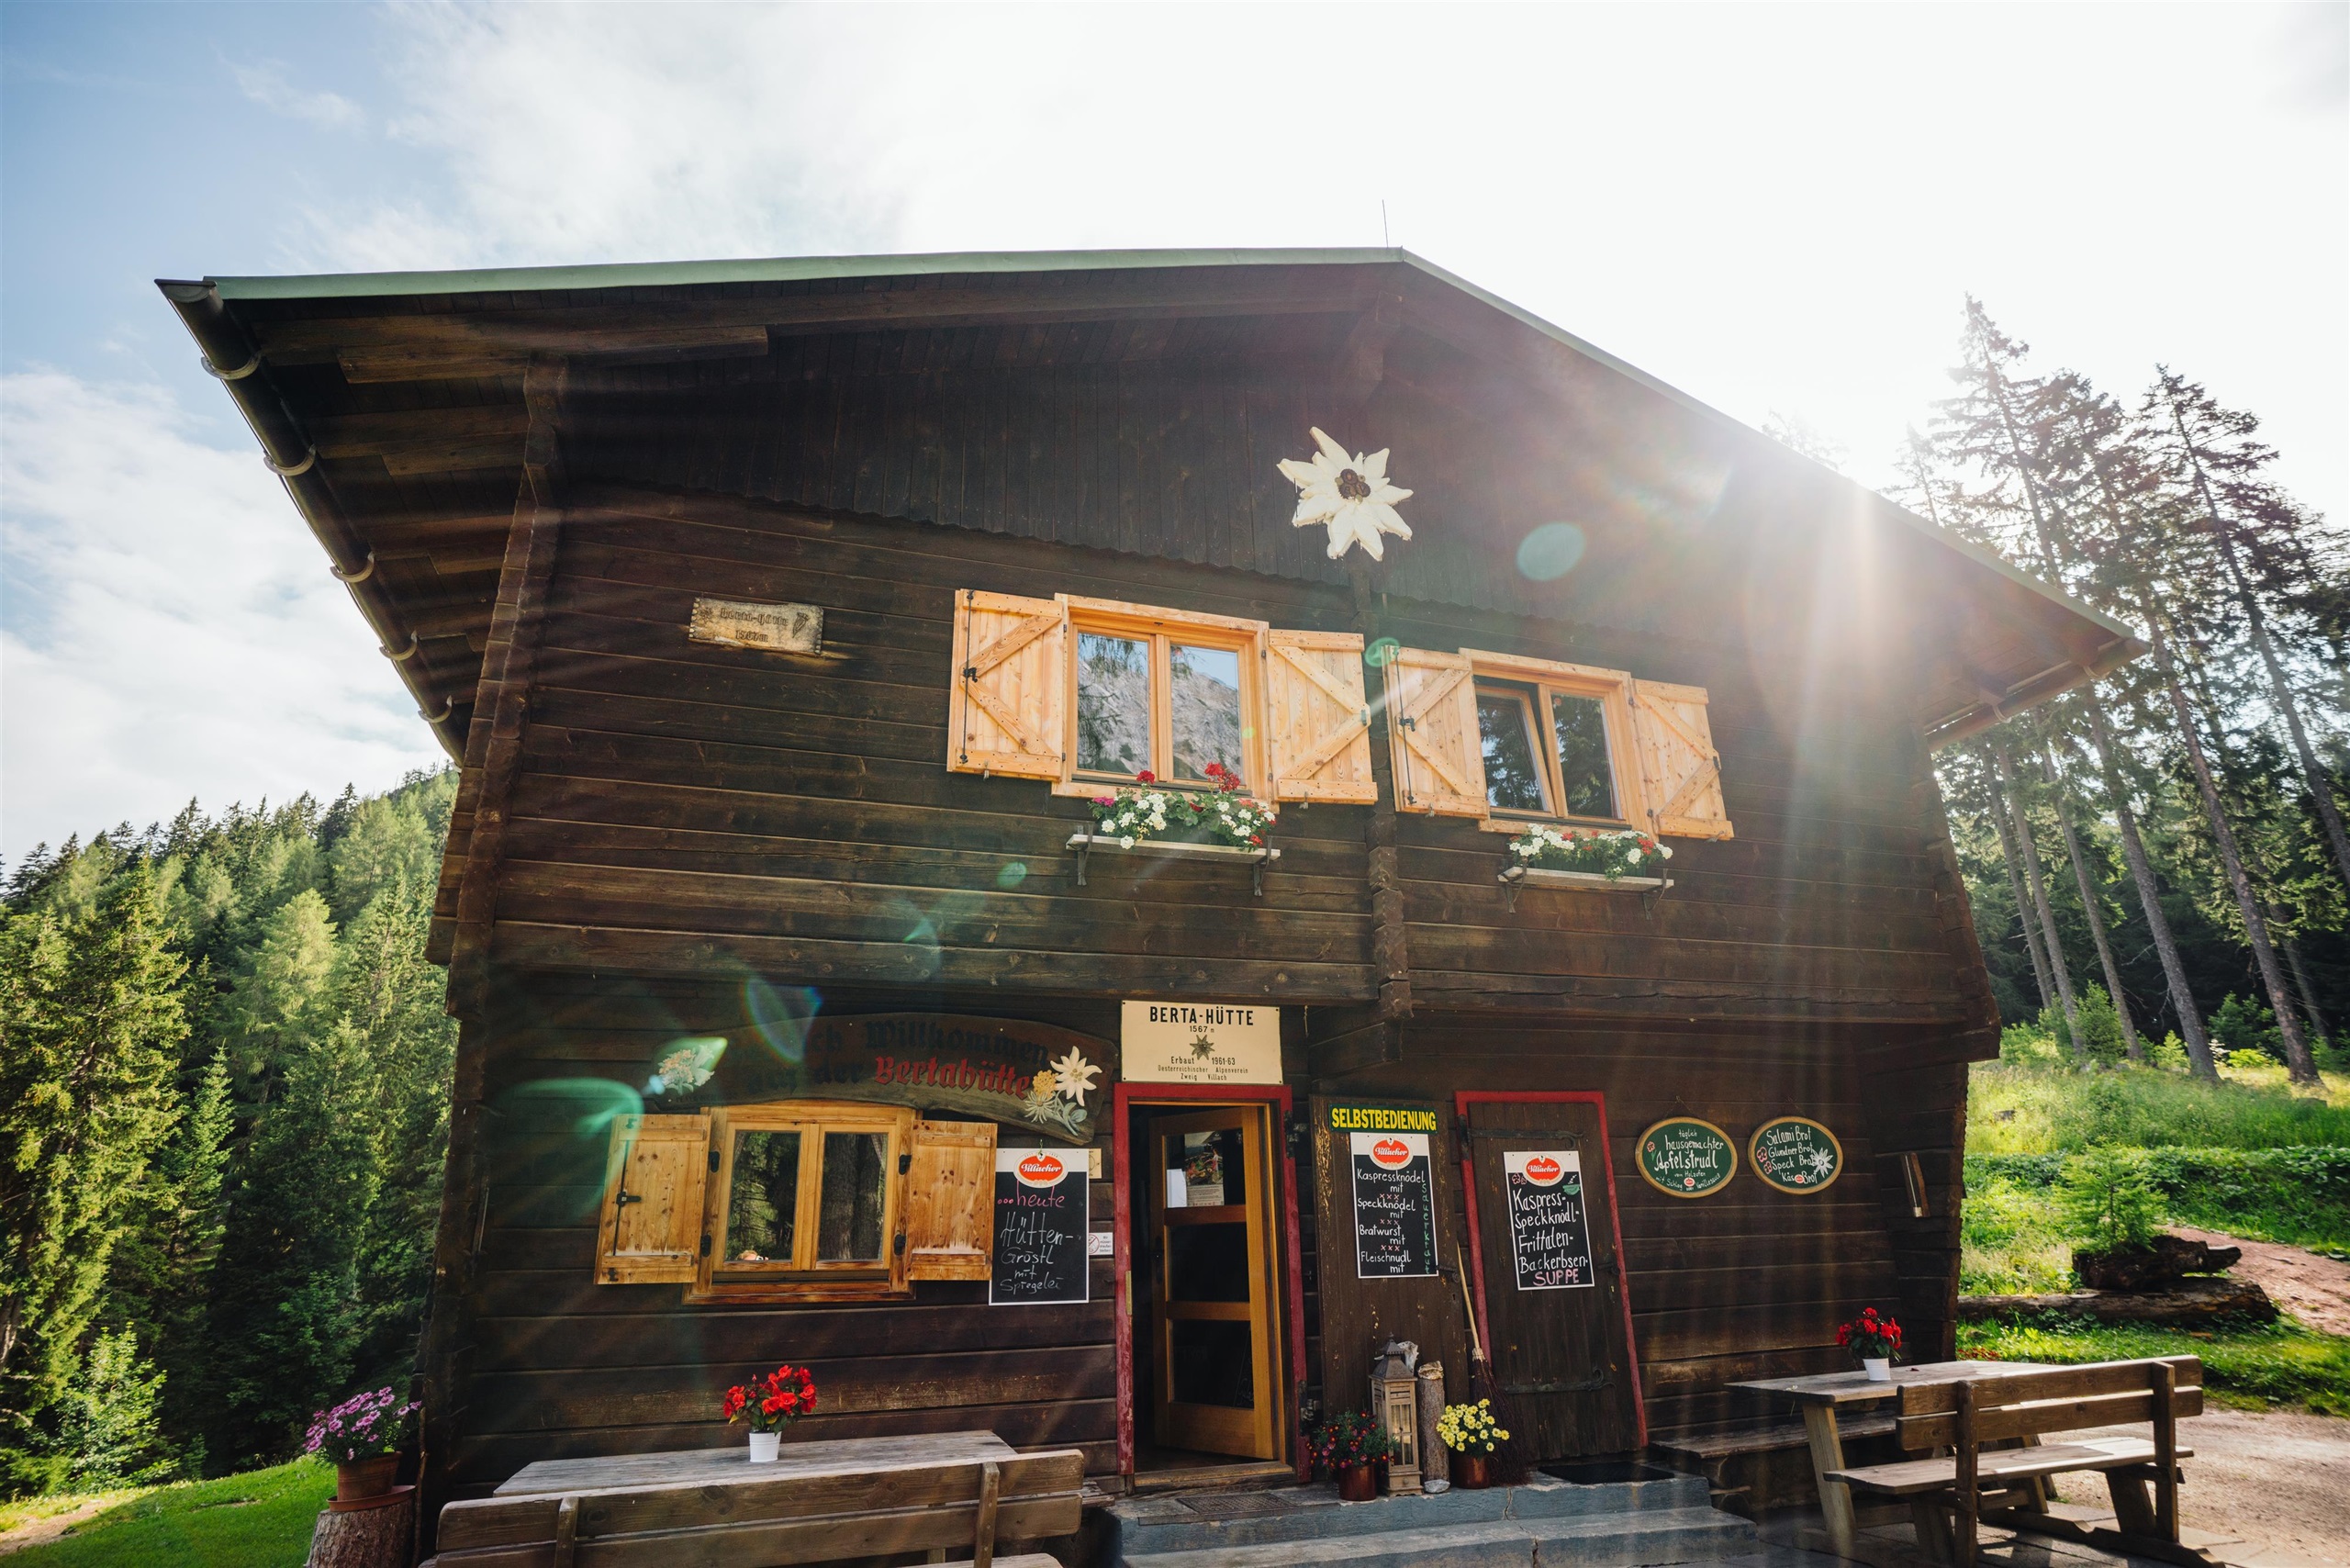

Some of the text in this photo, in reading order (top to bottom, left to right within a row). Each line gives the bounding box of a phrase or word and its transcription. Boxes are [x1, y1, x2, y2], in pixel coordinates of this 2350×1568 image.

[1149, 1006, 1254, 1026] BERTA-HÜTTE
[866, 1020, 1049, 1067] Willkommen
[1158, 1065, 1248, 1075] Oesterreichischer Alpenverein
[1181, 1073, 1227, 1081] Zweig Villach
[875, 1055, 1031, 1101] Bertahütte
[1332, 1108, 1437, 1131] SELBSTBEDIENUNG
[1678, 1128, 1697, 1139] täglich
[1766, 1126, 1811, 1146] Salami Brot
[1375, 1147, 1408, 1157] Villacher
[1664, 1135, 1724, 1154] hausgemachter
[1768, 1142, 1814, 1158] Glundner Brot
[1021, 1162, 1062, 1173] Villacher
[1528, 1164, 1560, 1174] Villacher
[1654, 1149, 1718, 1175] Apfelstrudl
[1771, 1155, 1815, 1174] Speck Brot
[1357, 1168, 1426, 1183] Kaspressknödel
[1782, 1170, 1818, 1184] Käs Brot
[1390, 1183, 1404, 1193] mit
[1666, 1178, 1684, 1191] Schlag
[1358, 1198, 1416, 1212] Speckknödel
[1513, 1188, 1566, 1215] Kaspress-
[1390, 1209, 1404, 1219] mit
[1360, 1224, 1401, 1237] Bratwurst
[1390, 1234, 1405, 1245] mit
[1518, 1226, 1573, 1254] Frittaten-
[1001, 1244, 1055, 1265] Gröstl
[1360, 1250, 1412, 1263] Fleischnudl
[1014, 1264, 1036, 1281] mit
[1390, 1263, 1404, 1273] mit
[1000, 1271, 1065, 1295] Spiegelei
[1533, 1268, 1580, 1286] SUPPE
